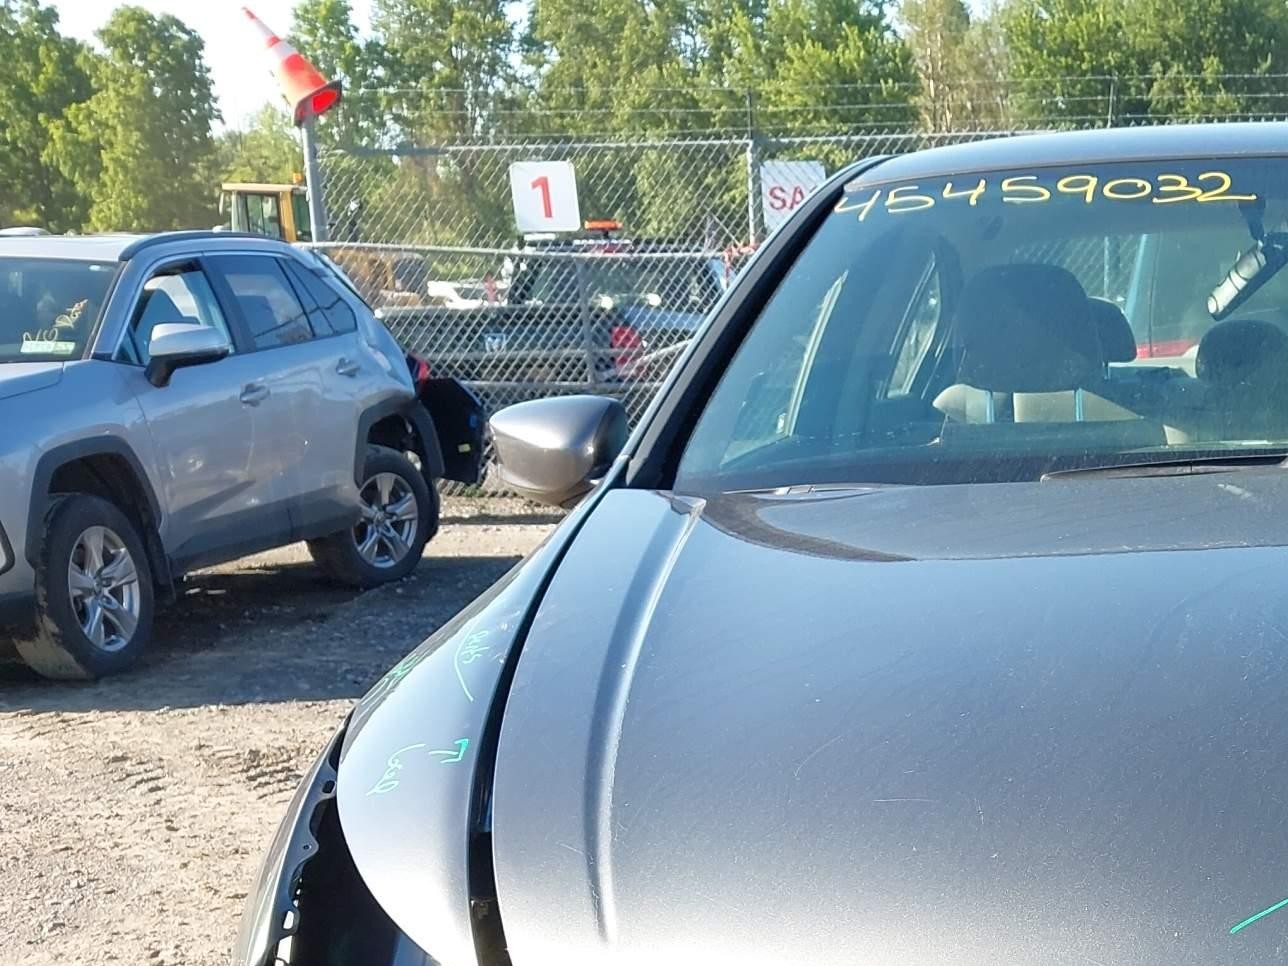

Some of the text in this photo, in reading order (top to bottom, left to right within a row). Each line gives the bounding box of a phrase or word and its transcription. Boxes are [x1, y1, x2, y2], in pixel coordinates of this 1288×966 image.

[531, 176, 553, 218] 1
[769, 185, 818, 210] SA
[834, 172, 1258, 221] 45459032
